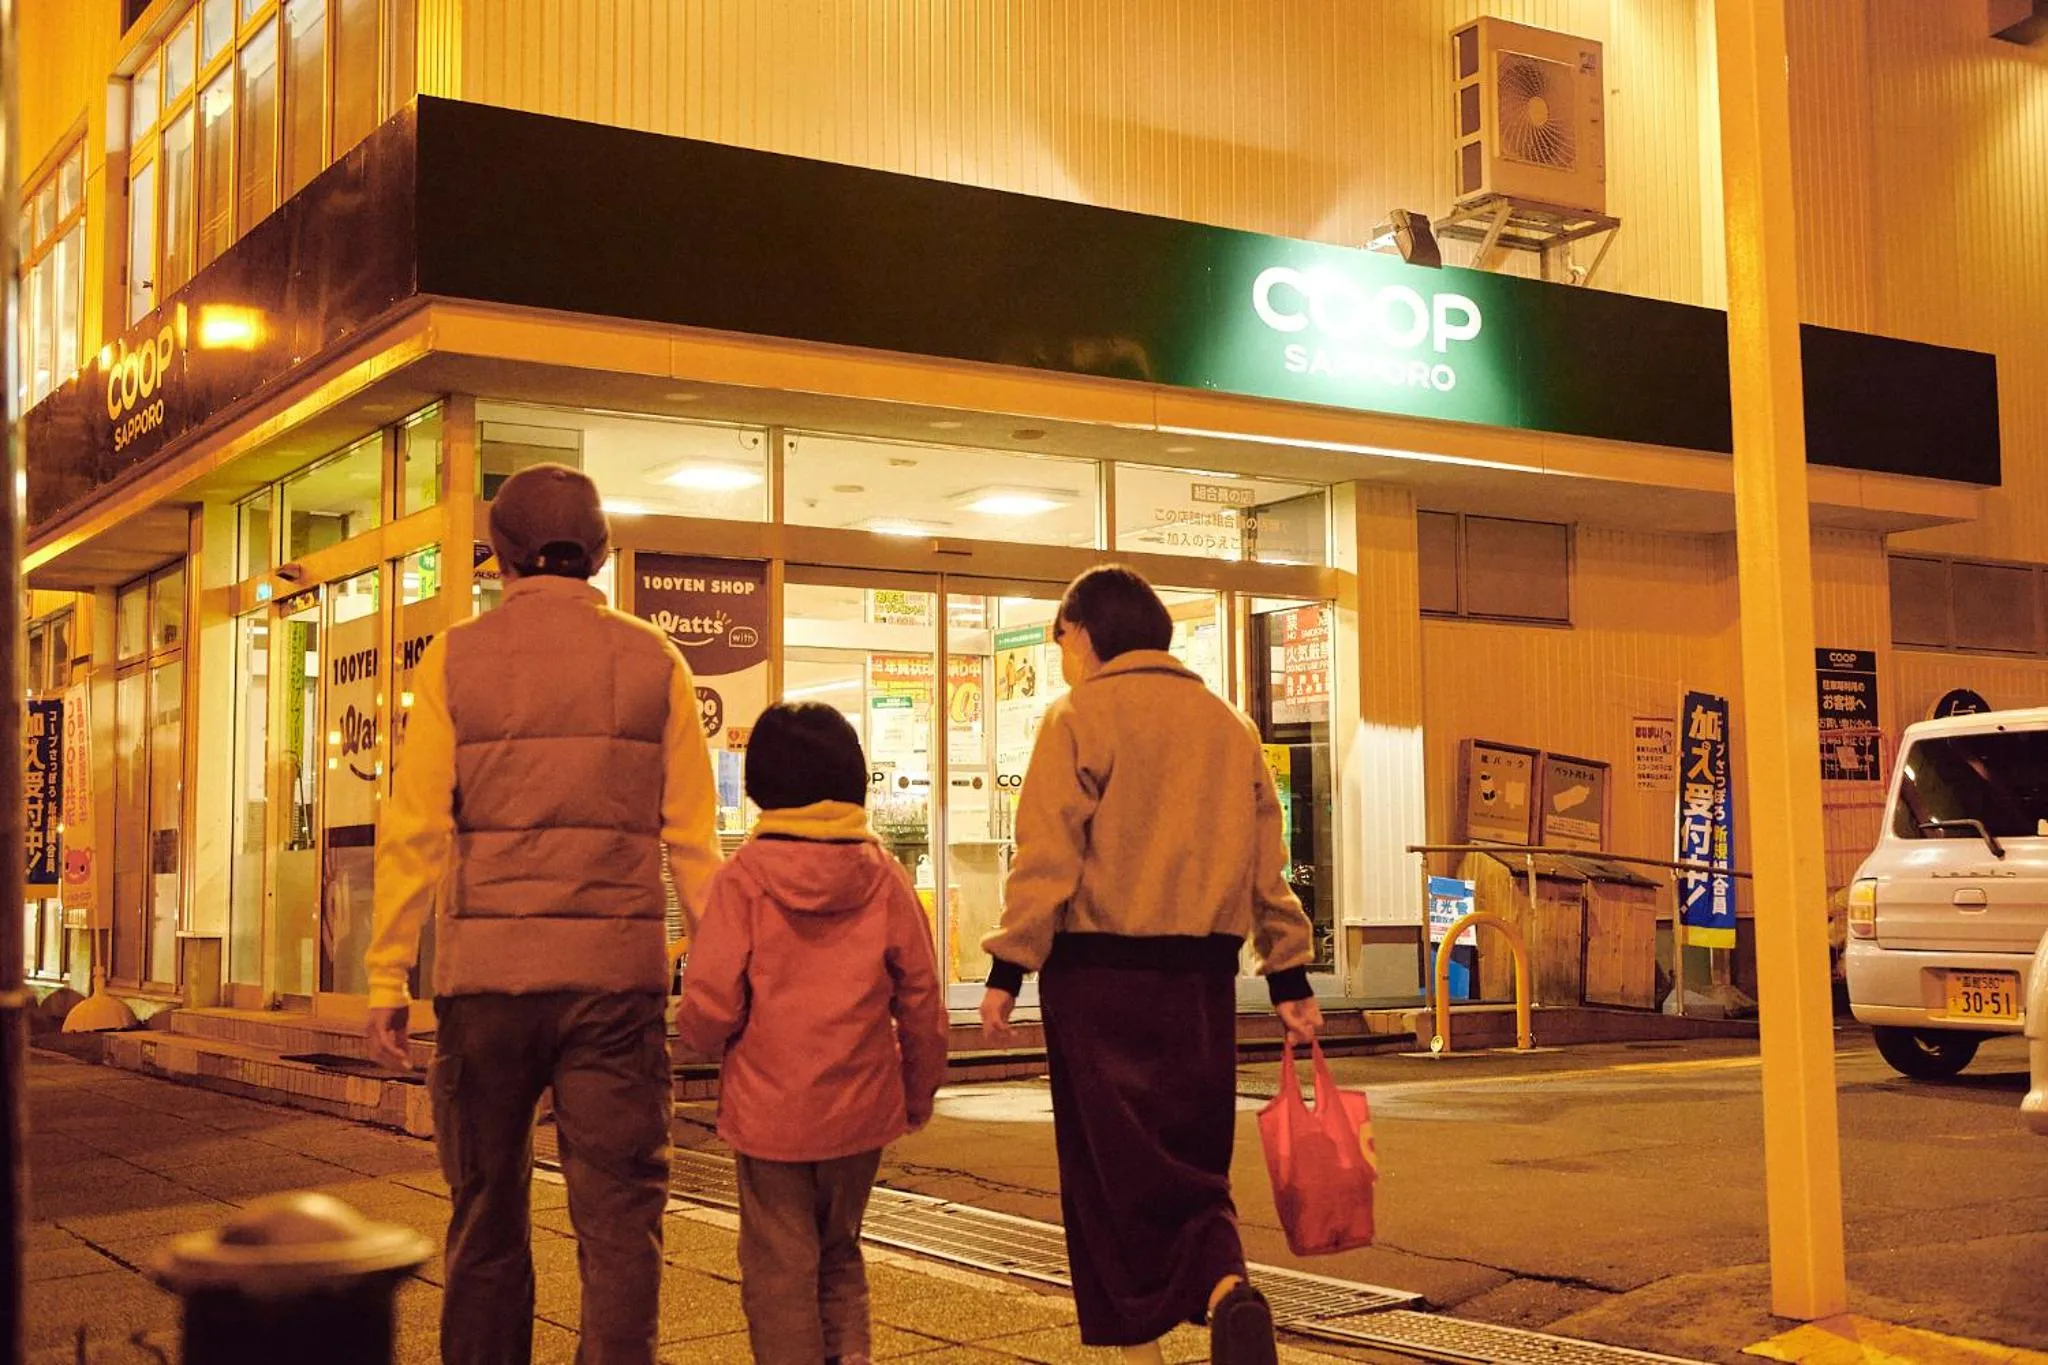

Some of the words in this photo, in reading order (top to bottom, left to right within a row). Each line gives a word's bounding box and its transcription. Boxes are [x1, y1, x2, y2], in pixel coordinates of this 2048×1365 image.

[1252, 266, 1482, 352] COOP
[107, 325, 174, 421] COOP
[1283, 343, 1456, 392] SAORO
[114, 400, 164, 452] SAPPORO
[642, 576, 705, 593] 100YEN
[711, 580, 755, 595] SHOP
[650, 610, 724, 635] Watts
[732, 632, 755, 643] with
[1829, 652, 1856, 662] COOP
[997, 774, 1022, 787] CO
[1962, 991, 2010, 1015] 30-51
